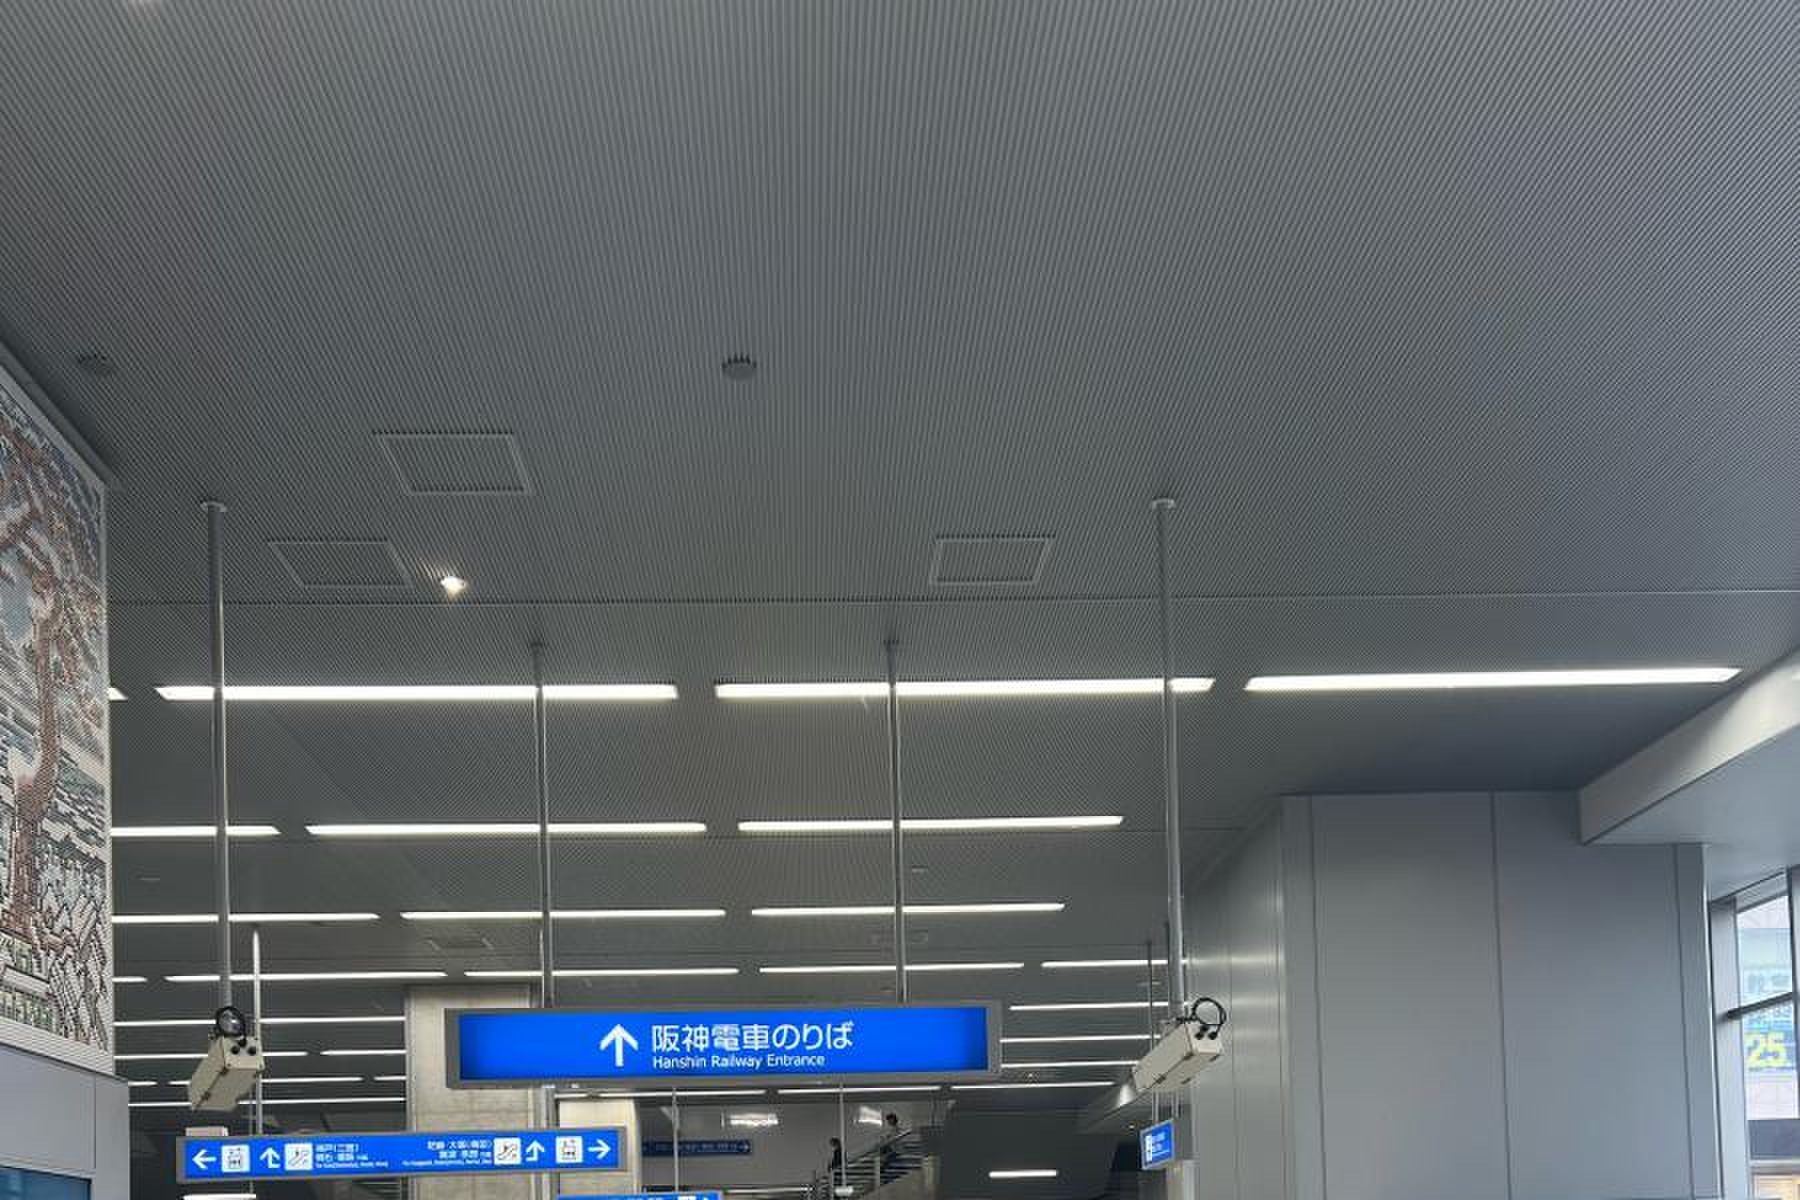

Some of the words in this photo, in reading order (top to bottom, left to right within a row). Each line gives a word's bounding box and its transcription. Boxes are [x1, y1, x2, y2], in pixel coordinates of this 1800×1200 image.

[651, 1021, 855, 1052] 阪神電車のりば
[653, 1055, 707, 1069] Hanshin
[711, 1055, 761, 1069] Railway
[767, 1053, 825, 1068] Entrance
